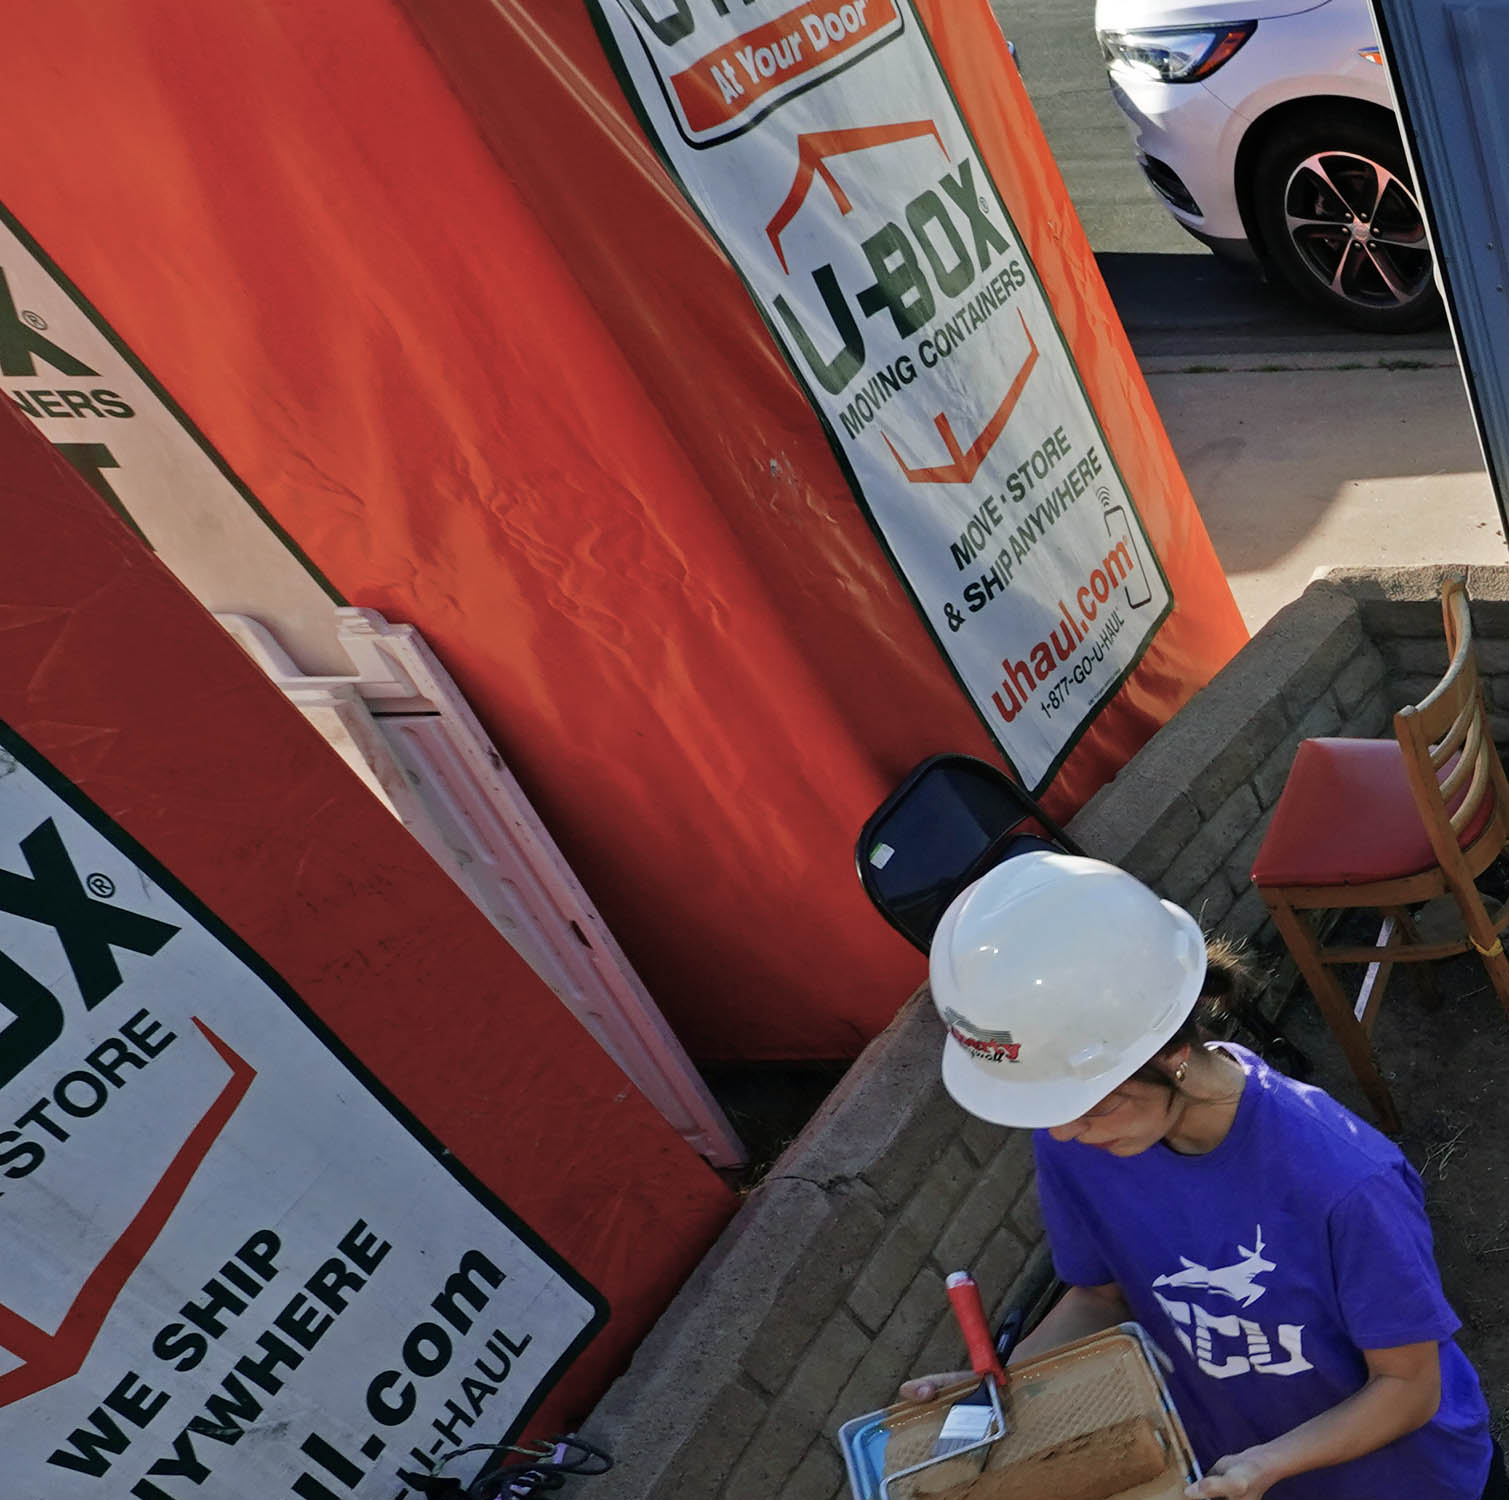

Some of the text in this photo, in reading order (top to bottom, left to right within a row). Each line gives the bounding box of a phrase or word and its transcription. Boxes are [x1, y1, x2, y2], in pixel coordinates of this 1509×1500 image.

[709, 1, 868, 104] At Your Door
[773, 157, 1010, 396] U-BOX
[838, 260, 1026, 440] MOVING CONTAINERS
[943, 446, 1102, 632] & SHIP ANYWHERE
[949, 425, 1072, 571] MOVE STORE
[991, 541, 1135, 722] uhaul.com
[1041, 609, 1125, 719] 1-877-GO-U-HAUL
[0, 1007, 177, 1179] STORE
[47, 1229, 284, 1479] WE SHIP
